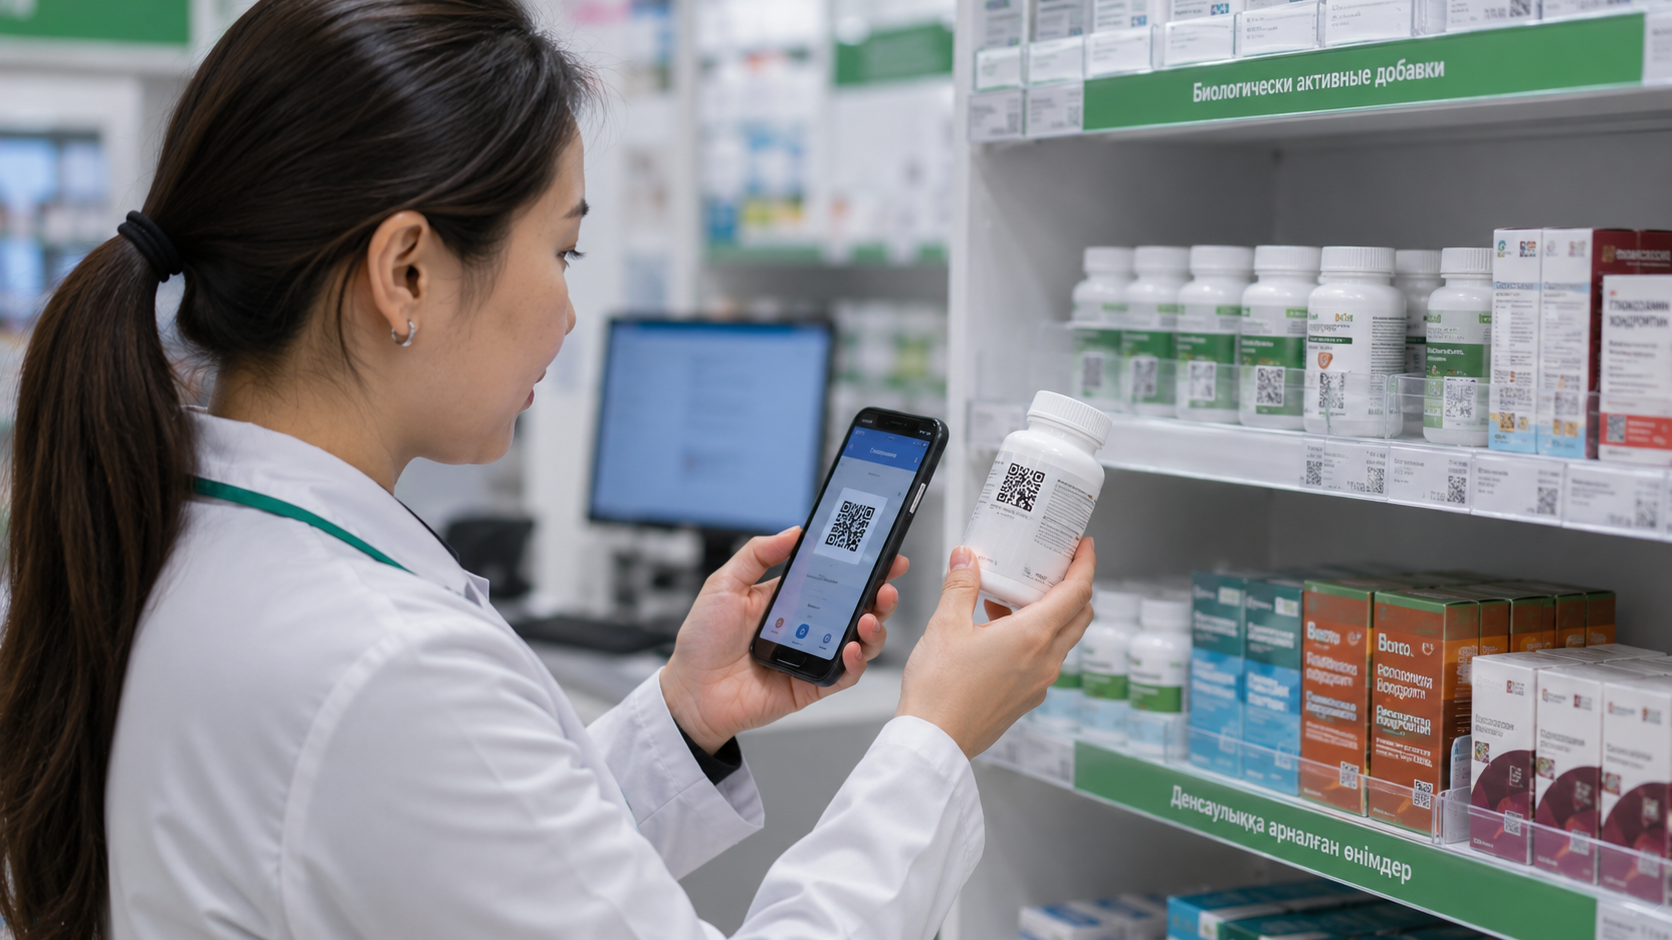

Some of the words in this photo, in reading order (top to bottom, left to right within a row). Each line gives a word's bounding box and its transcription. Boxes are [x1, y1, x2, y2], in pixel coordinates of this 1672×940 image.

[1193, 76, 1293, 102] Биологически
[1296, 68, 1371, 92] активные
[1375, 58, 1445, 87] добавки
[1170, 785, 1265, 834] Денсаулыққа
[1269, 821, 1339, 857] арналған
[1344, 845, 1412, 884] өнімдер
